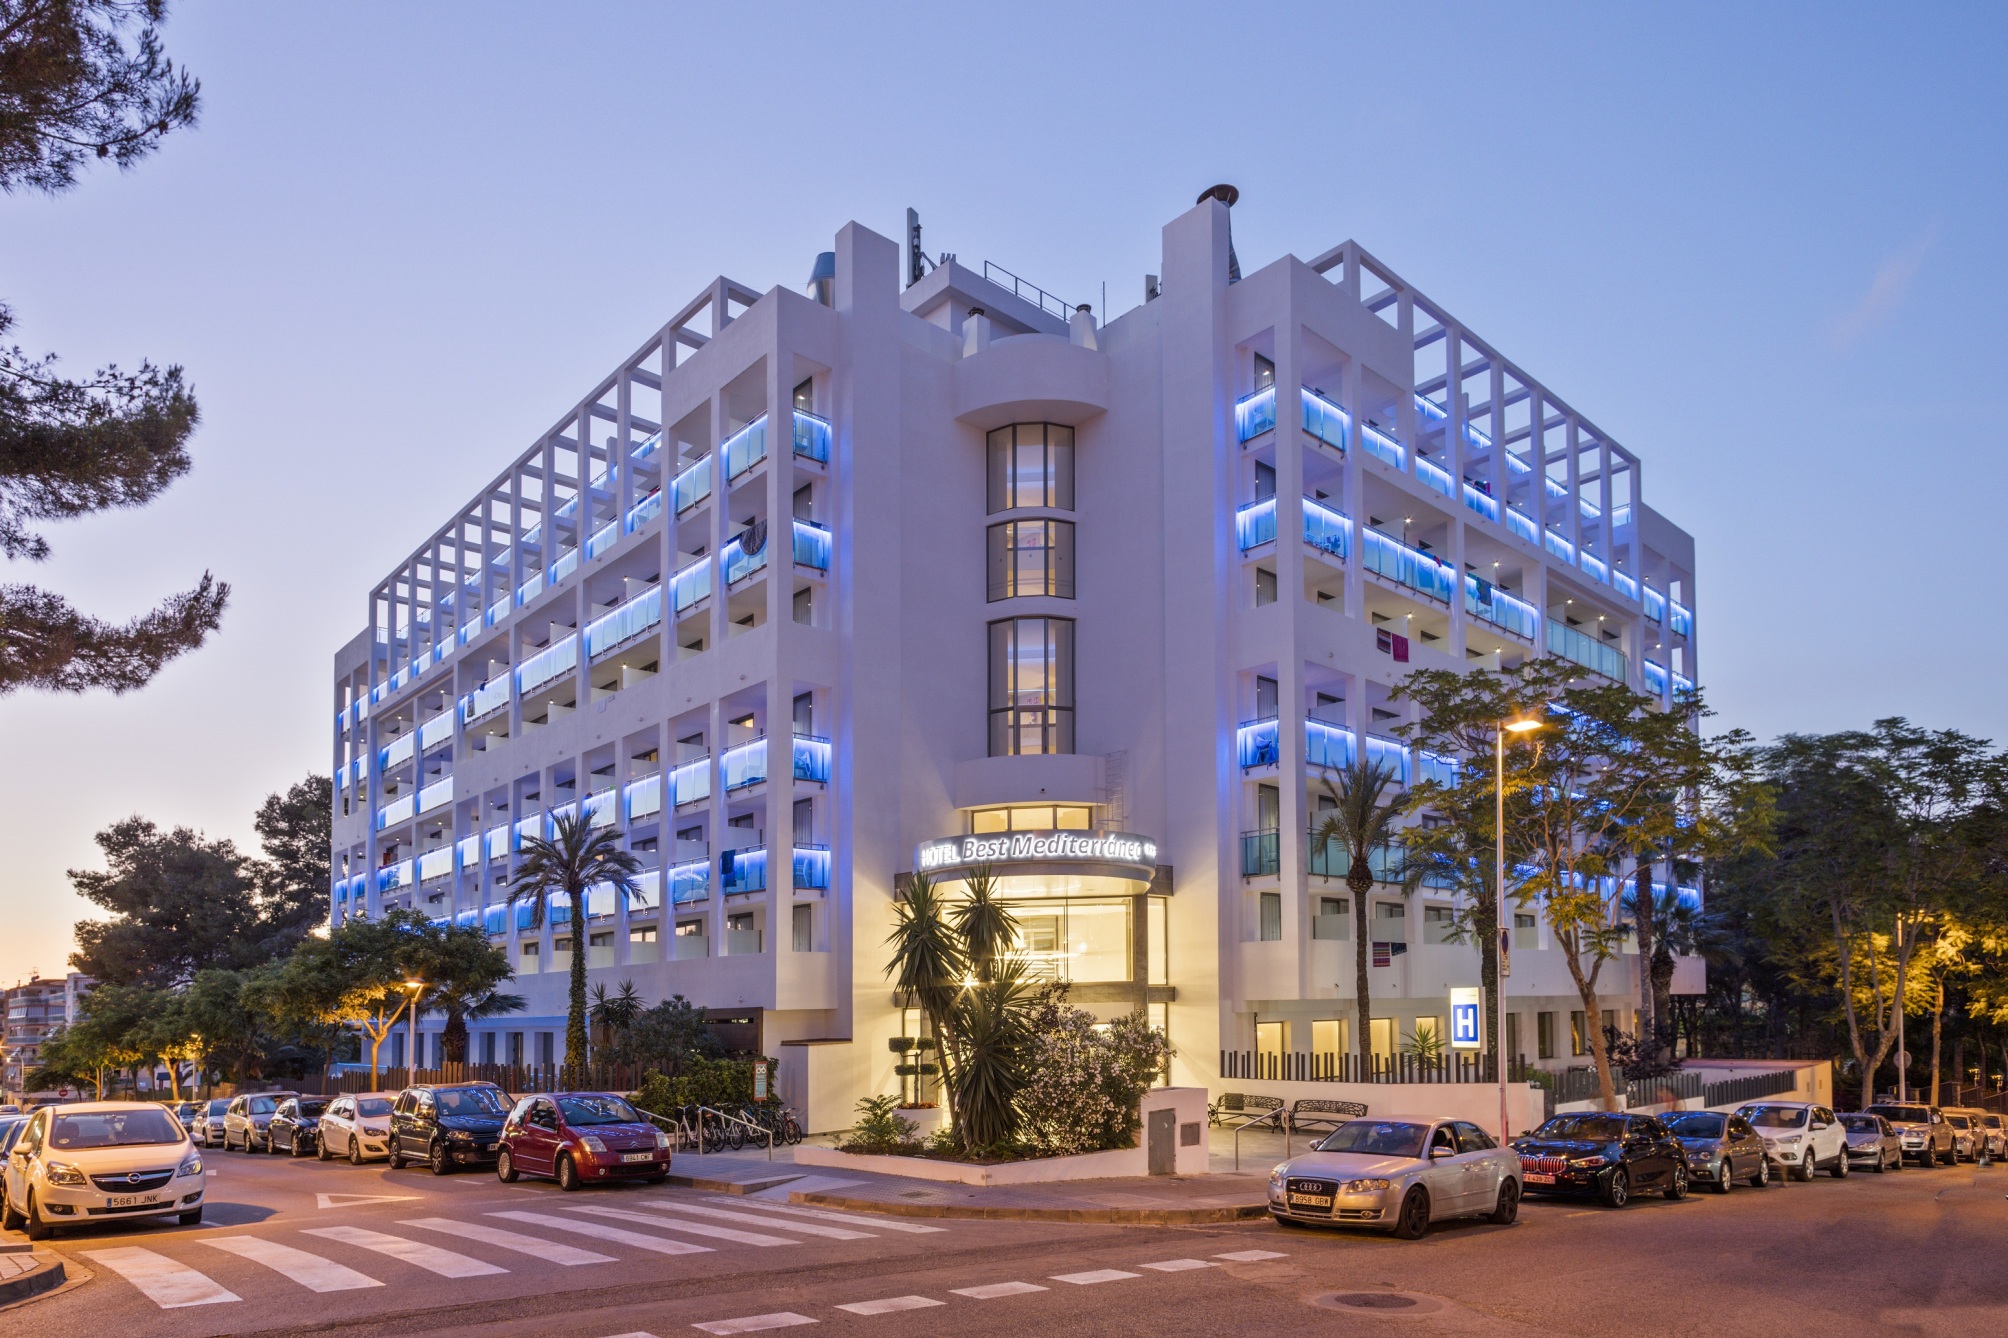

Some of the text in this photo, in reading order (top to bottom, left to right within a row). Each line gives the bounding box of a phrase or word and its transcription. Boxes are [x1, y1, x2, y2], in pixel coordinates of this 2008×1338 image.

[921, 833, 1142, 867] HOTEL Best Mediterráneo
[1456, 1008, 1475, 1038] H
[113, 1194, 158, 1206] 5661 JNK
[1295, 1195, 1312, 1204] 8958
